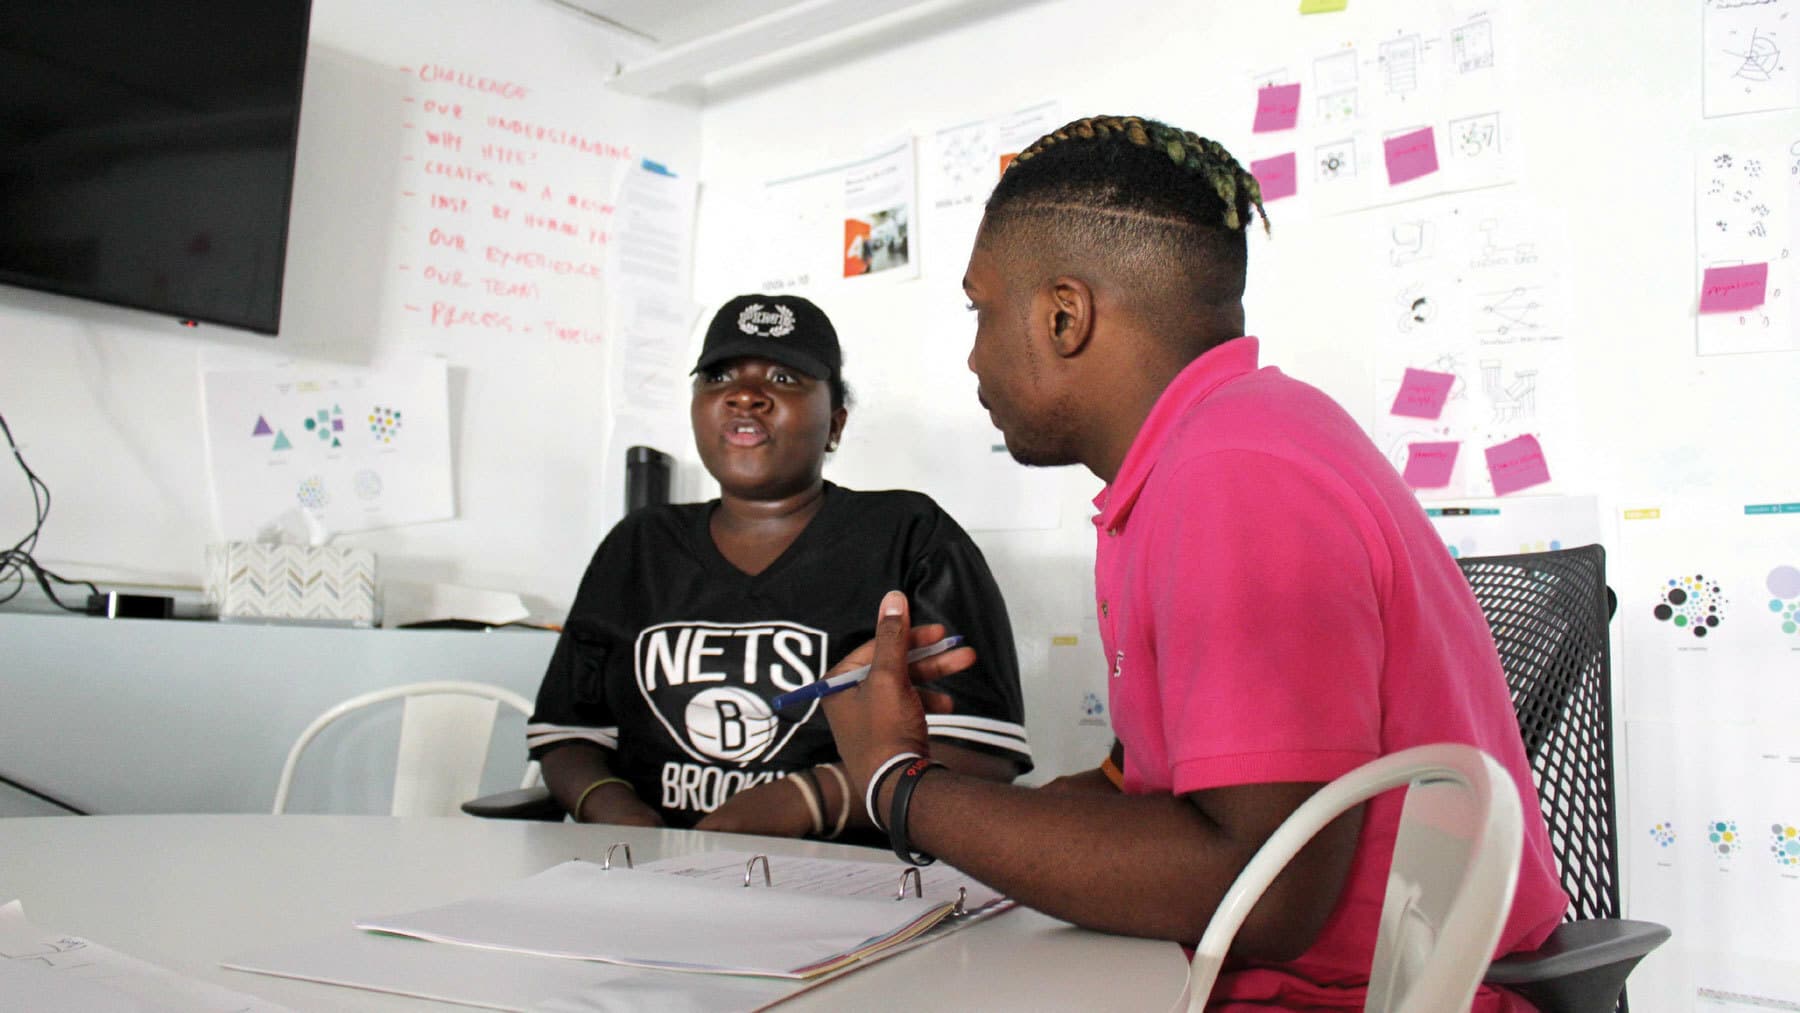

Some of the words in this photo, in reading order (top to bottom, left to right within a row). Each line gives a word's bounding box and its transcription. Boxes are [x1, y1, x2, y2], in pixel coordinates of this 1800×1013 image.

[423, 98, 463, 120] OUR
[429, 226, 467, 253] OUR
[645, 627, 815, 692] NETS
[714, 699, 746, 752] B
